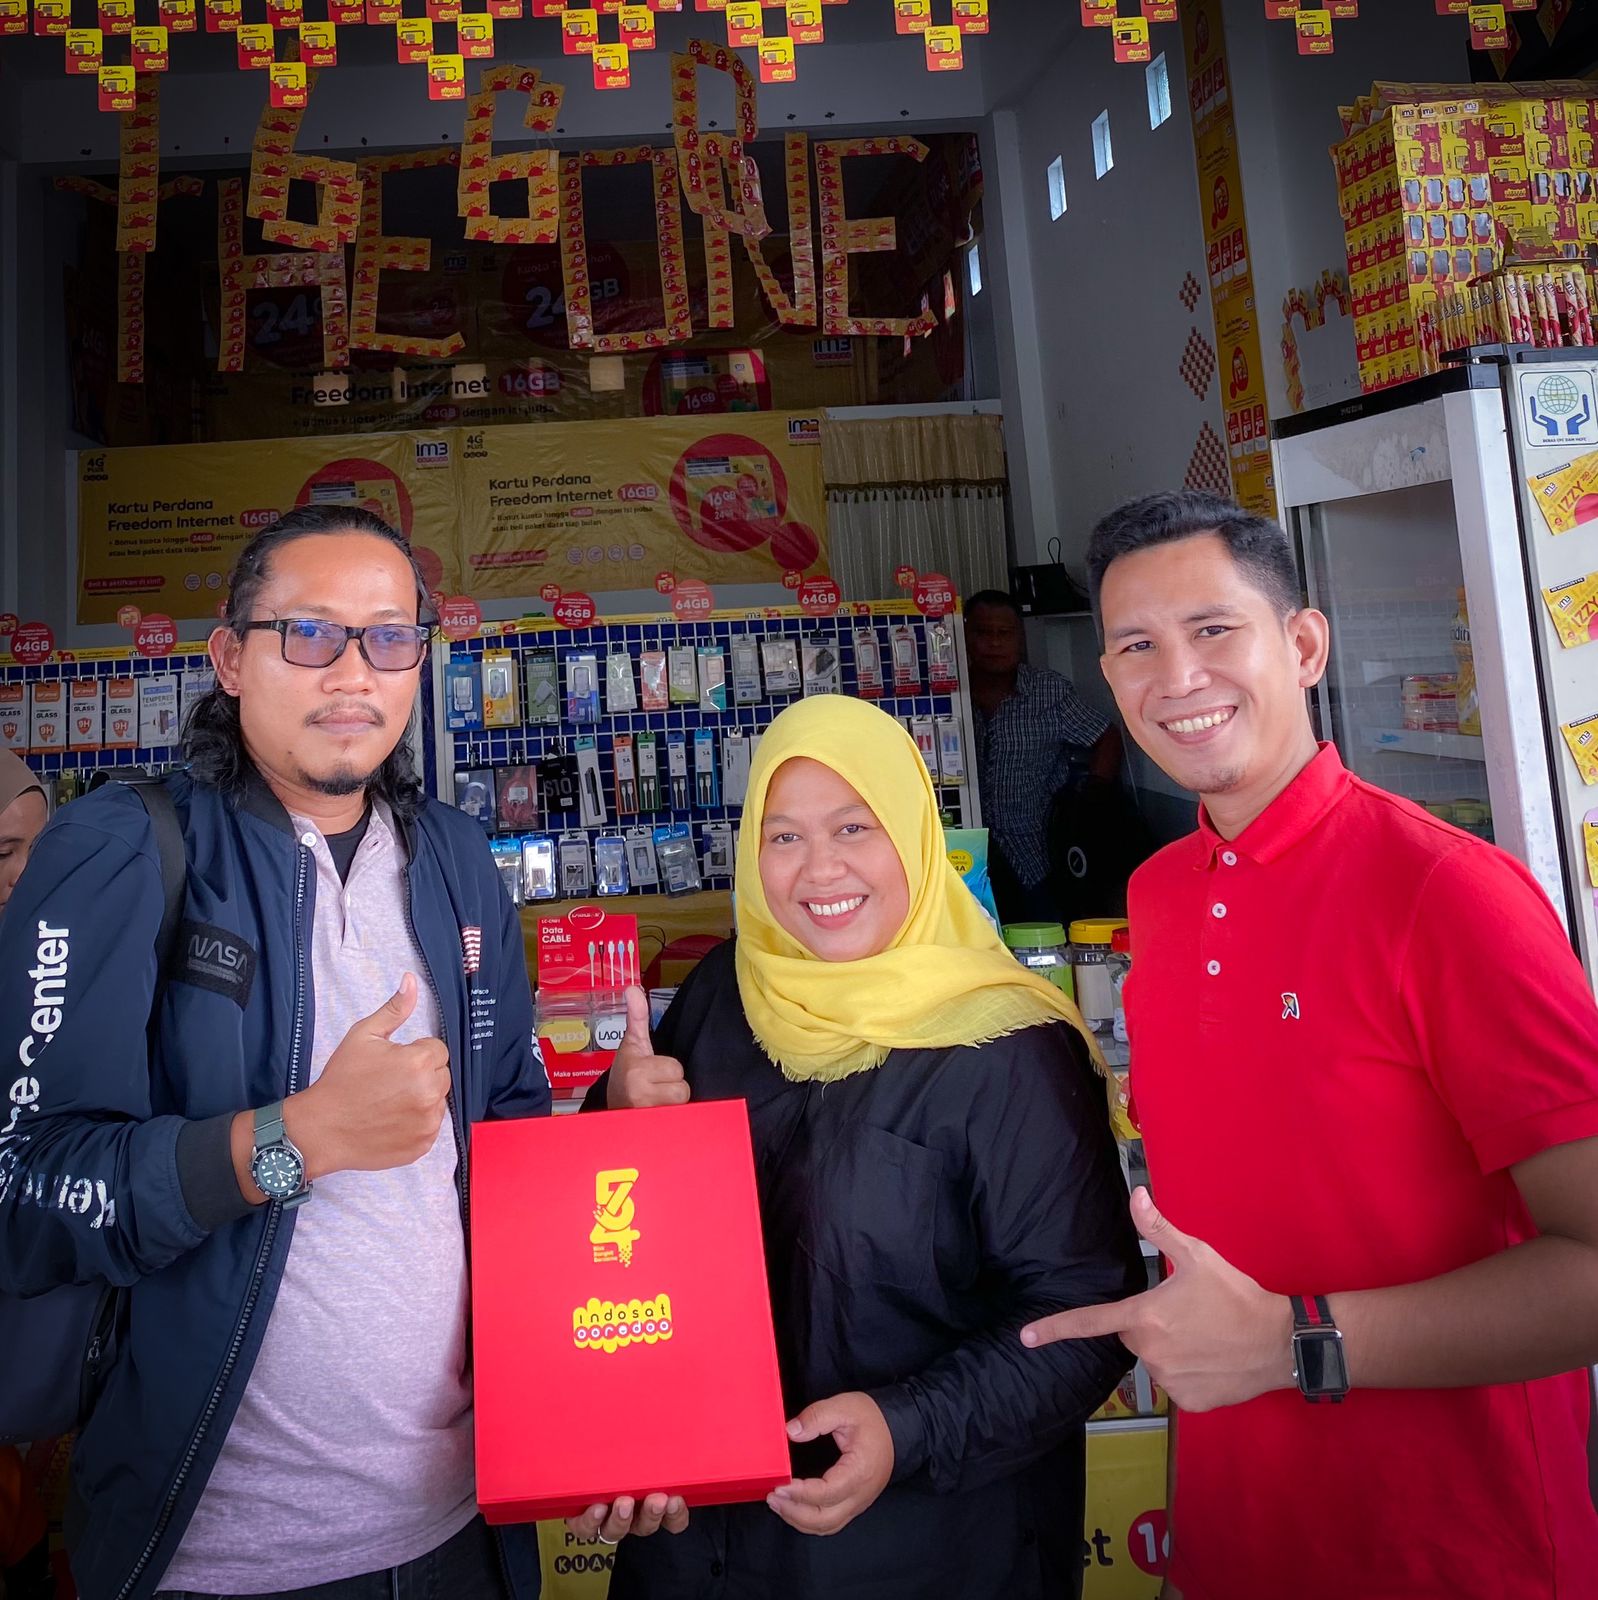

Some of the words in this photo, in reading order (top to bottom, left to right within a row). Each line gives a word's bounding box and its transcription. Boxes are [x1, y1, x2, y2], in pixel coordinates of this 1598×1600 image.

[290, 384, 393, 407] Freedom
[401, 377, 491, 399] Internet
[503, 370, 560, 393] 16GB
[467, 434, 483, 444] 4G
[416, 440, 448, 457] im3
[87, 457, 104, 467] 4G
[489, 478, 528, 490] Kartu
[532, 474, 592, 488] Perdana
[490, 494, 552, 508] Freedom
[557, 489, 614, 502] Internet
[620, 486, 657, 499] 16GB
[1556, 479, 1586, 514] IZZY
[108, 502, 149, 514] Kartu
[153, 499, 213, 512] Perdana
[108, 518, 172, 531] Freedom
[177, 515, 235, 528] Internet
[242, 510, 279, 525] 16GB
[675, 598, 710, 611] 64GB
[802, 592, 837, 605] 64GB
[917, 592, 952, 605] 64GB
[556, 608, 592, 619] 64GB
[443, 615, 478, 627] 64GB
[138, 633, 174, 646] 64GB
[14, 641, 50, 653] 64GB
[142, 694, 175, 703] TEMPERED
[0, 709, 21, 718] GLASS
[36, 711, 58, 719] GLASS
[73, 705, 95, 713] GLASS
[110, 707, 132, 715] GLASS
[4, 724, 17, 733] 9H
[78, 719, 91, 729] 9H
[114, 721, 128, 731] 9H
[40, 726, 54, 735] 9H
[545, 777, 573, 798] S10
[541, 934, 572, 943] CABLE
[188, 934, 248, 976] NASA
[598, 1031, 626, 1040] LAOL
[579, 1303, 666, 1324] indosat
[576, 1318, 669, 1342] ooredoo
